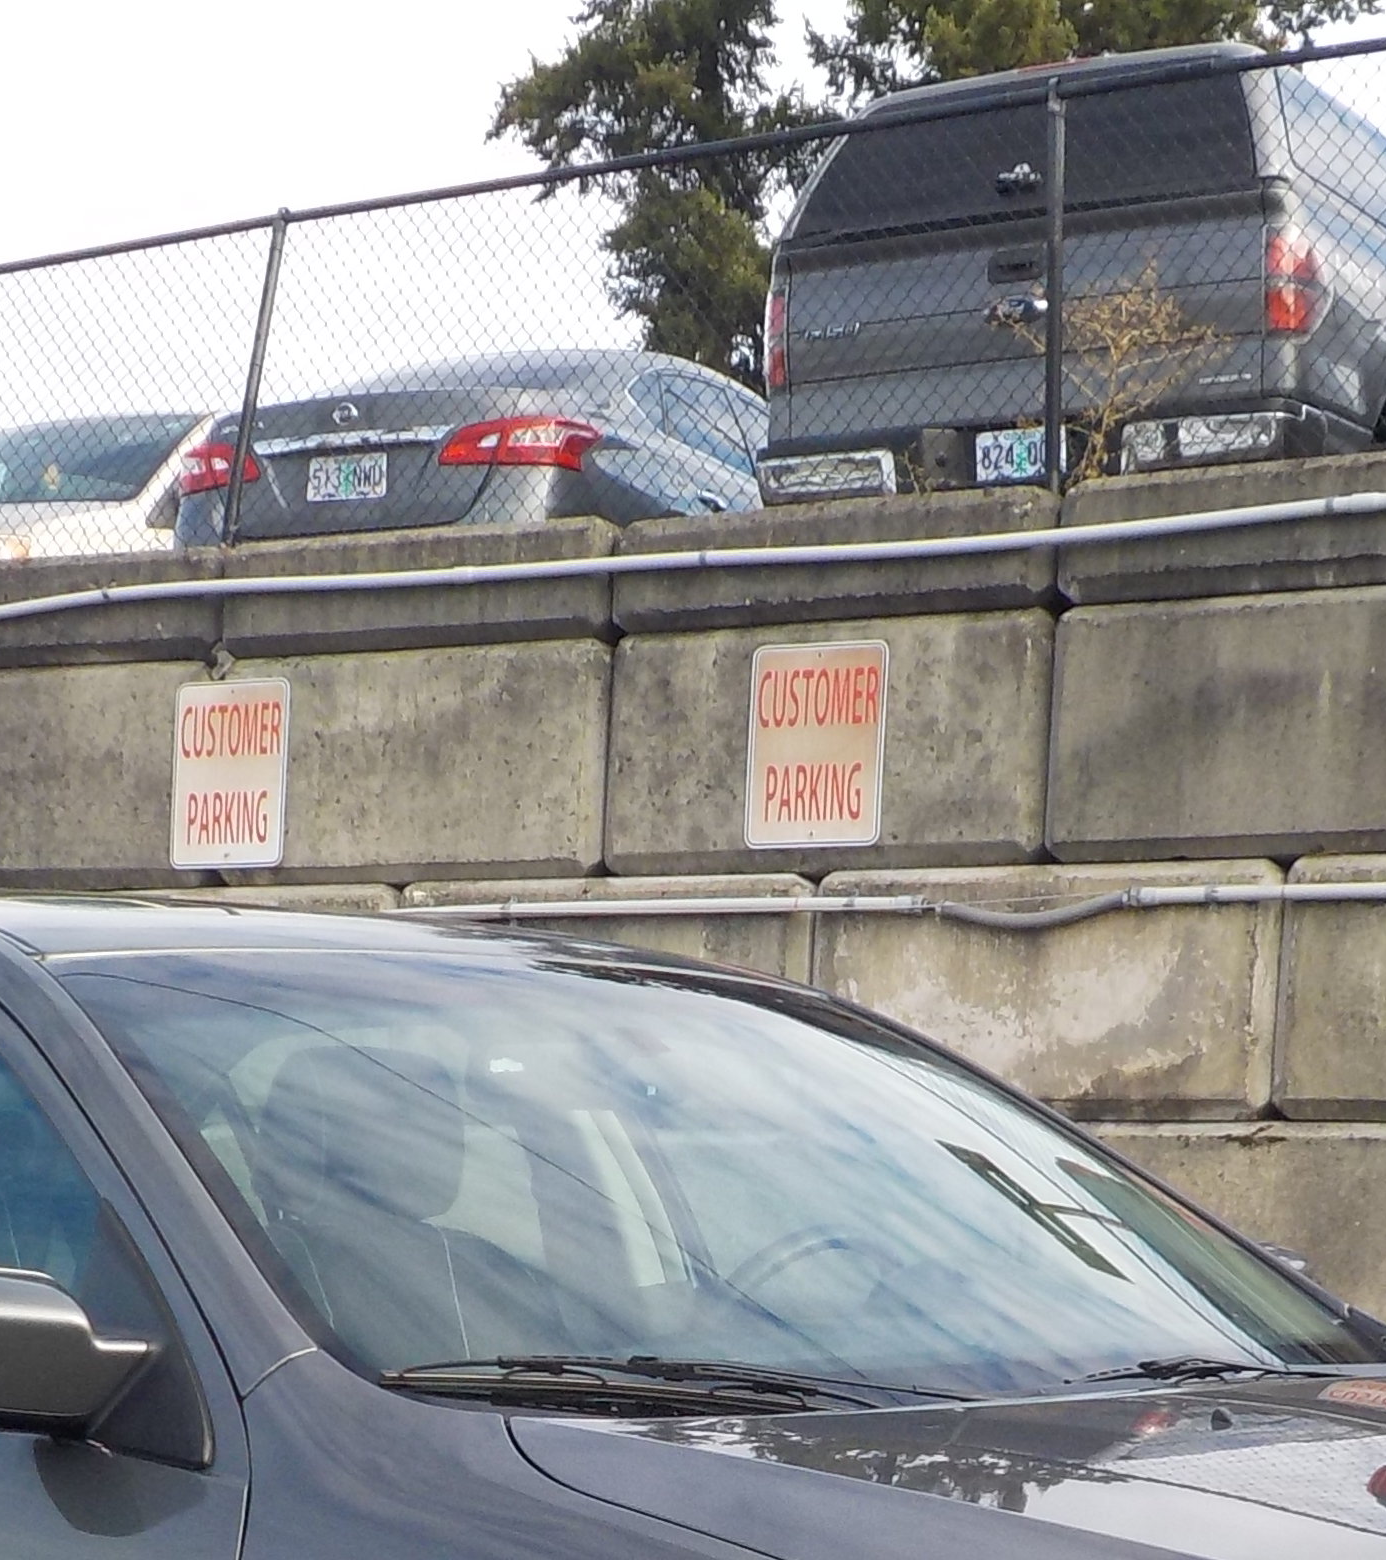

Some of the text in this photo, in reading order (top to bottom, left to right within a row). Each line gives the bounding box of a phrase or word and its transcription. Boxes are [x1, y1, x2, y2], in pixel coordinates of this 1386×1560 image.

[981, 444, 1014, 470] 824
[758, 666, 880, 728] CUSTOMER
[181, 701, 282, 759] CUSTOMER
[186, 790, 268, 846] PARKING
[764, 762, 862, 822] PARKING
